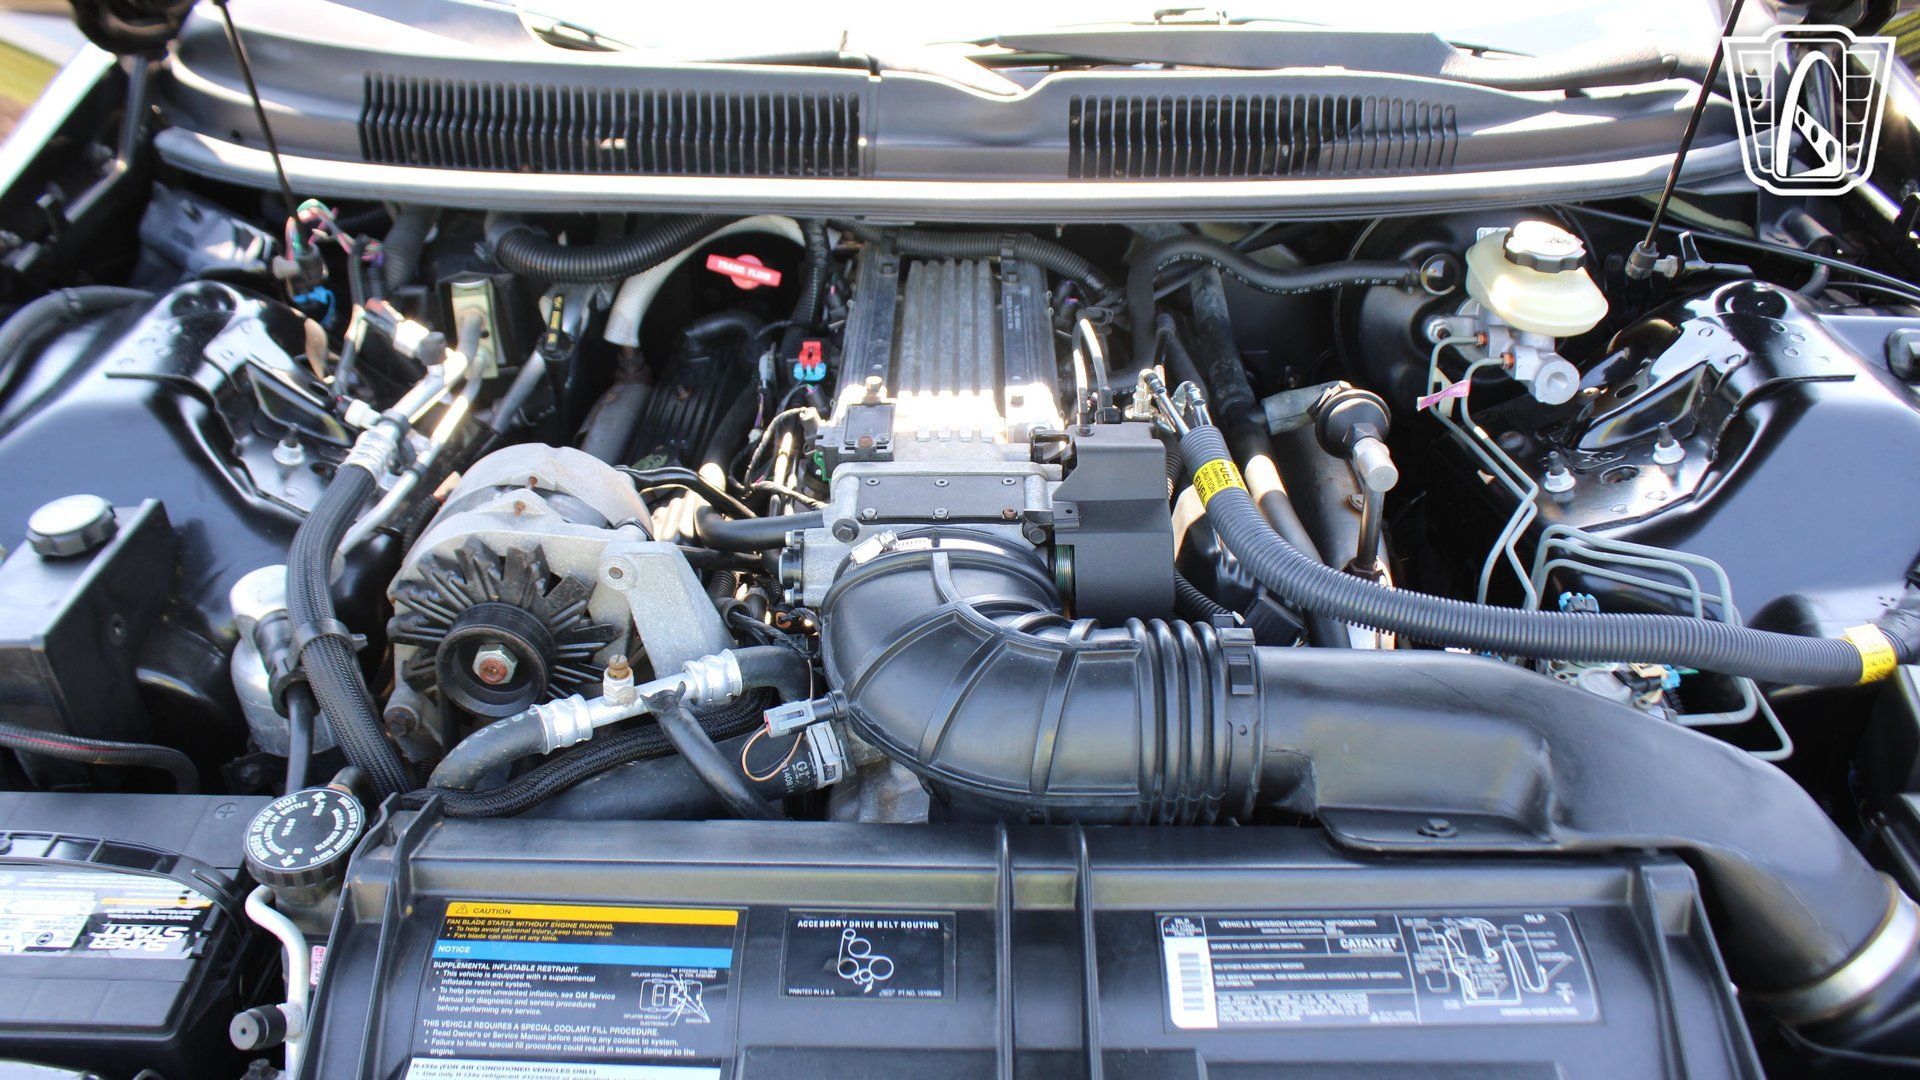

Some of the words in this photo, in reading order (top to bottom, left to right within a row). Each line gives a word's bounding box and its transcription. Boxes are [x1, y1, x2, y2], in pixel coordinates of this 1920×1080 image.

[718, 260, 745, 275] TRANS
[747, 268, 771, 281] FLUID
[1202, 468, 1216, 493] CAUTION
[1209, 463, 1224, 487] FLAMMABLE
[1217, 462, 1232, 485] FUEL
[1195, 475, 1207, 503] FUEL
[274, 795, 298, 810] HOT
[271, 815, 282, 823] IN
[280, 801, 308, 816] BOTTLE
[252, 809, 275, 832] OPEN
[249, 835, 271, 860] NEVER
[314, 830, 340, 851] CLOSED
[310, 849, 335, 864] ALIGN
[501, 927, 530, 935] personal
[798, 920, 847, 928] ACCESSORY
[849, 920, 875, 929] DRIVE
[877, 921, 899, 929] BELT
[901, 921, 939, 929] ROUTING
[1218, 920, 1251, 928] VEHICLE
[1289, 920, 1324, 928] CONTROL
[100, 924, 190, 943] START
[88, 937, 168, 952] SUPER
[438, 945, 471, 953] NOTICE
[1340, 937, 1397, 950] CATALYST
[433, 961, 490, 970] SUPPLEMENTAL
[492, 963, 535, 972] INFLATABLE
[537, 965, 579, 973] RESTRAINT.
[443, 969, 457, 977] This
[459, 970, 483, 978] vehicle
[492, 972, 525, 980] equipped
[548, 974, 596, 982] supplemental
[441, 978, 473, 986] inflatable
[505, 981, 532, 989] system.
[440, 986, 447, 994] To
[448, 987, 464, 995] help
[465, 987, 492, 996] prevent
[493, 989, 528, 997] unwanted
[575, 991, 588, 999] GM
[589, 992, 616, 1000] Service
[788, 988, 813, 996] PRINTED
[436, 1004, 459, 1012] before
[460, 1005, 499, 1015] performing
[501, 1007, 513, 1015] any
[515, 1007, 542, 1015] service.
[438, 995, 464, 1003] Manual
[465, 995, 475, 1003] for
[476, 996, 513, 1005] diagnostic
[514, 998, 528, 1006] and
[529, 999, 555, 1007] service
[555, 1000, 596, 1009] procedures
[423, 1019, 439, 1027] THIS
[441, 1019, 472, 1028] VEHICLE
[474, 1021, 512, 1030] REQUIRES
[513, 1023, 520, 1031] A
[520, 1022, 552, 1032] SPECIAL
[554, 1024, 591, 1033] COOLANT
[592, 1025, 607, 1034] FILL
[610, 1026, 659, 1036] PROCEDURE.
[432, 1029, 451, 1037] Read
[452, 1029, 482, 1038] Owner's
[492, 1031, 519, 1040] Service
[520, 1032, 547, 1041] Manual
[548, 1033, 571, 1041] before
[572, 1034, 597, 1044] adding
[598, 1036, 611, 1044] any
[613, 1036, 640, 1045] coolant
[641, 1037, 649, 1045] to
[651, 1038, 678, 1047] system.
[430, 1048, 456, 1057] engine.
[431, 1037, 455, 1046] Failure
[456, 1039, 464, 1047] to
[465, 1039, 487, 1047] follow
[488, 1040, 514, 1049] special
[515, 1041, 524, 1049] fill
[525, 1041, 562, 1051] procedure
[563, 1043, 584, 1052] could
[584, 1044, 605, 1053] result
[606, 1045, 614, 1053] in
[615, 1046, 642, 1054] serious
[643, 1047, 673, 1056] damage
[674, 1048, 681, 1056] to
[683, 1048, 696, 1056] the
[476, 1065, 531, 1073] CONDITIONED
